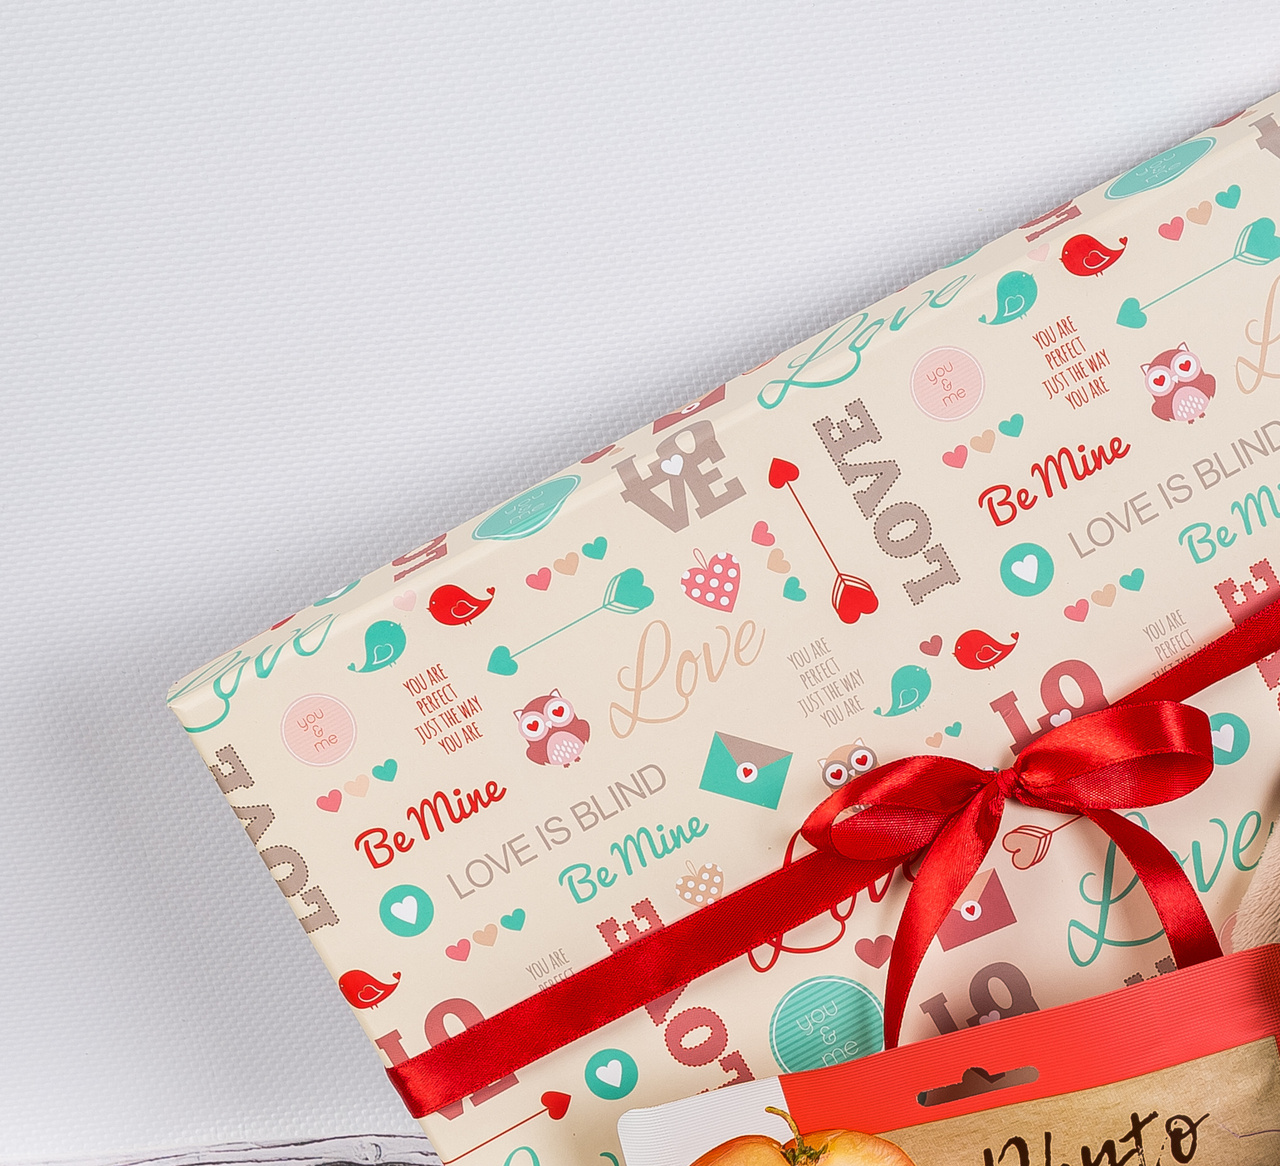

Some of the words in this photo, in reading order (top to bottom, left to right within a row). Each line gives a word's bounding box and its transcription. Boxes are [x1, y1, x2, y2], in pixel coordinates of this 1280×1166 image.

[757, 274, 977, 410] Love
[1032, 326, 1056, 350] YOU
[1056, 316, 1077, 338] ARE
[1045, 336, 1086, 370] PERFECT
[926, 361, 954, 386] you
[941, 378, 953, 392] &
[1042, 372, 1069, 400] JUST
[1066, 362, 1089, 382] THE
[1085, 349, 1110, 373] WAY
[942, 387, 966, 407] me
[1065, 386, 1089, 410] YOU
[1089, 376, 1110, 399] ARE
[978, 484, 1038, 527] Be
[1031, 436, 1131, 498] Mine
[812, 398, 961, 606] LOVE
[1067, 491, 1160, 559] LOVE
[1157, 473, 1194, 510] IS
[1178, 522, 1238, 564] Be
[1142, 619, 1166, 642] YOU
[1166, 609, 1186, 631] ARE
[787, 647, 811, 670] YOU
[810, 637, 831, 659] ARE
[1155, 629, 1195, 661] PERFECT
[402, 673, 428, 697] YOU
[426, 663, 449, 686] ARE
[610, 620, 765, 739] Love
[800, 657, 840, 689] PERFECT
[416, 683, 458, 717] PERFECT
[797, 691, 825, 718] JUST
[821, 681, 844, 701] THE
[839, 669, 864, 692] WAY
[296, 708, 325, 733] you
[414, 717, 442, 745] JUST
[439, 708, 462, 729] THE
[457, 695, 484, 720] WAY
[820, 705, 844, 728] YOU
[843, 695, 864, 717] ARE
[312, 724, 325, 738] &
[314, 732, 339, 753] me
[438, 731, 463, 756] YOU
[461, 722, 484, 744] ARE
[354, 827, 415, 870] Be
[406, 780, 507, 840] Mine
[447, 833, 539, 900] LOVE
[535, 816, 572, 851] IS
[569, 763, 667, 832] BLIND
[558, 863, 618, 904] Be
[610, 816, 709, 876] Mine
[1067, 810, 1275, 967] Lve
[525, 957, 550, 980] YOU
[549, 948, 570, 969] ARE
[795, 1000, 839, 1035] you
[820, 1026, 838, 1045] &
[820, 1038, 860, 1067] me
